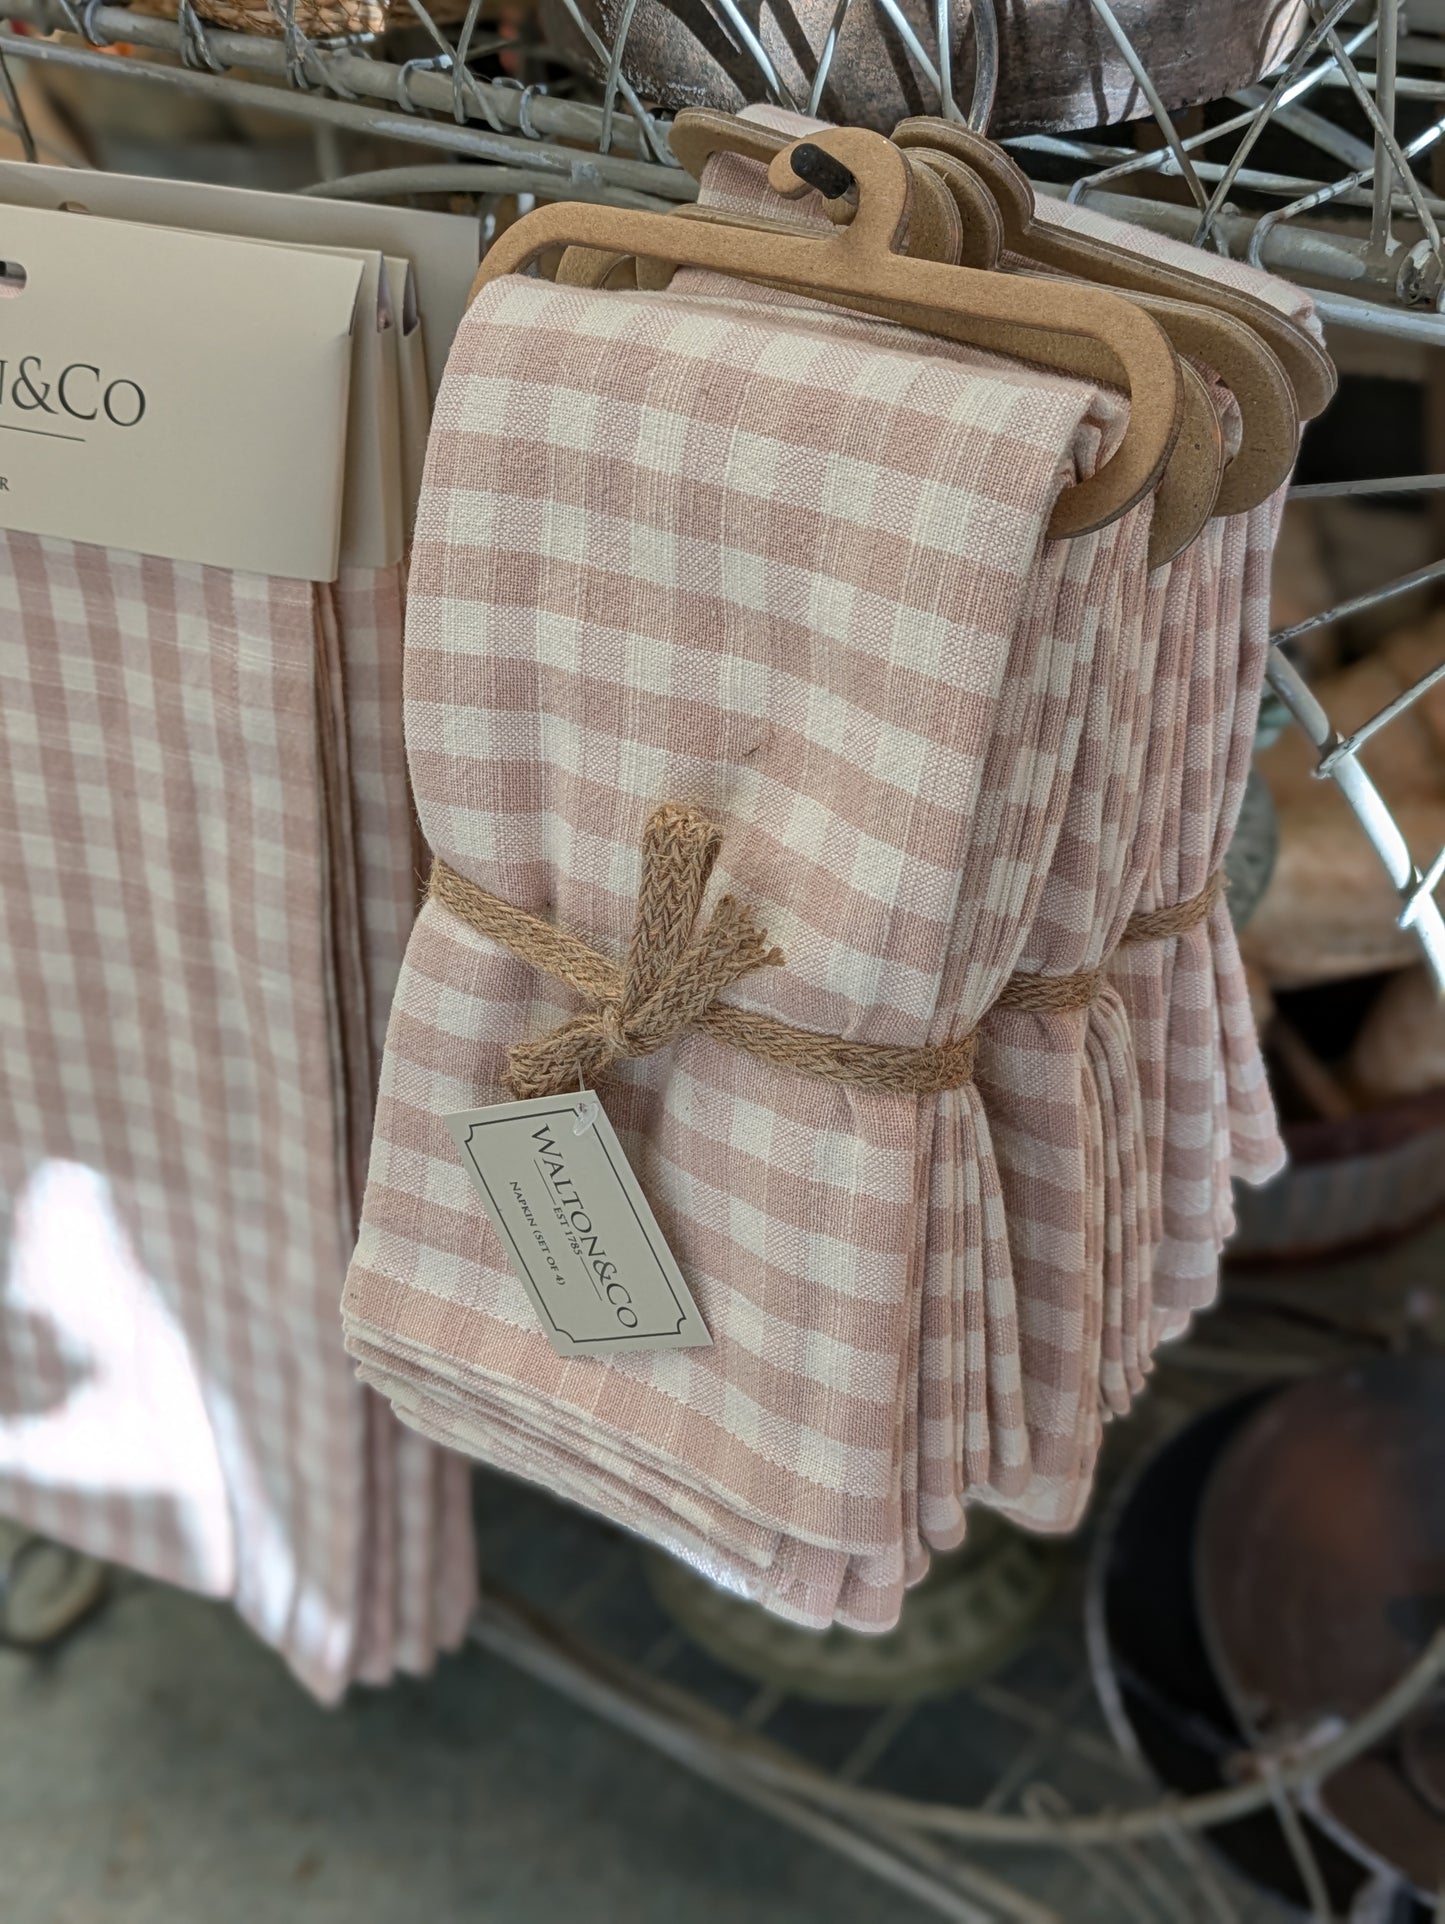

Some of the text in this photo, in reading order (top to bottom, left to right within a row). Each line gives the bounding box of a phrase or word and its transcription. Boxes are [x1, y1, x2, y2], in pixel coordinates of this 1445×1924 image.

[509, 1180, 566, 1286] NAPKIN (SET OF 4)
[531, 1123, 638, 1328] WALTON&CO
[553, 1206, 583, 1257] EST 1785
